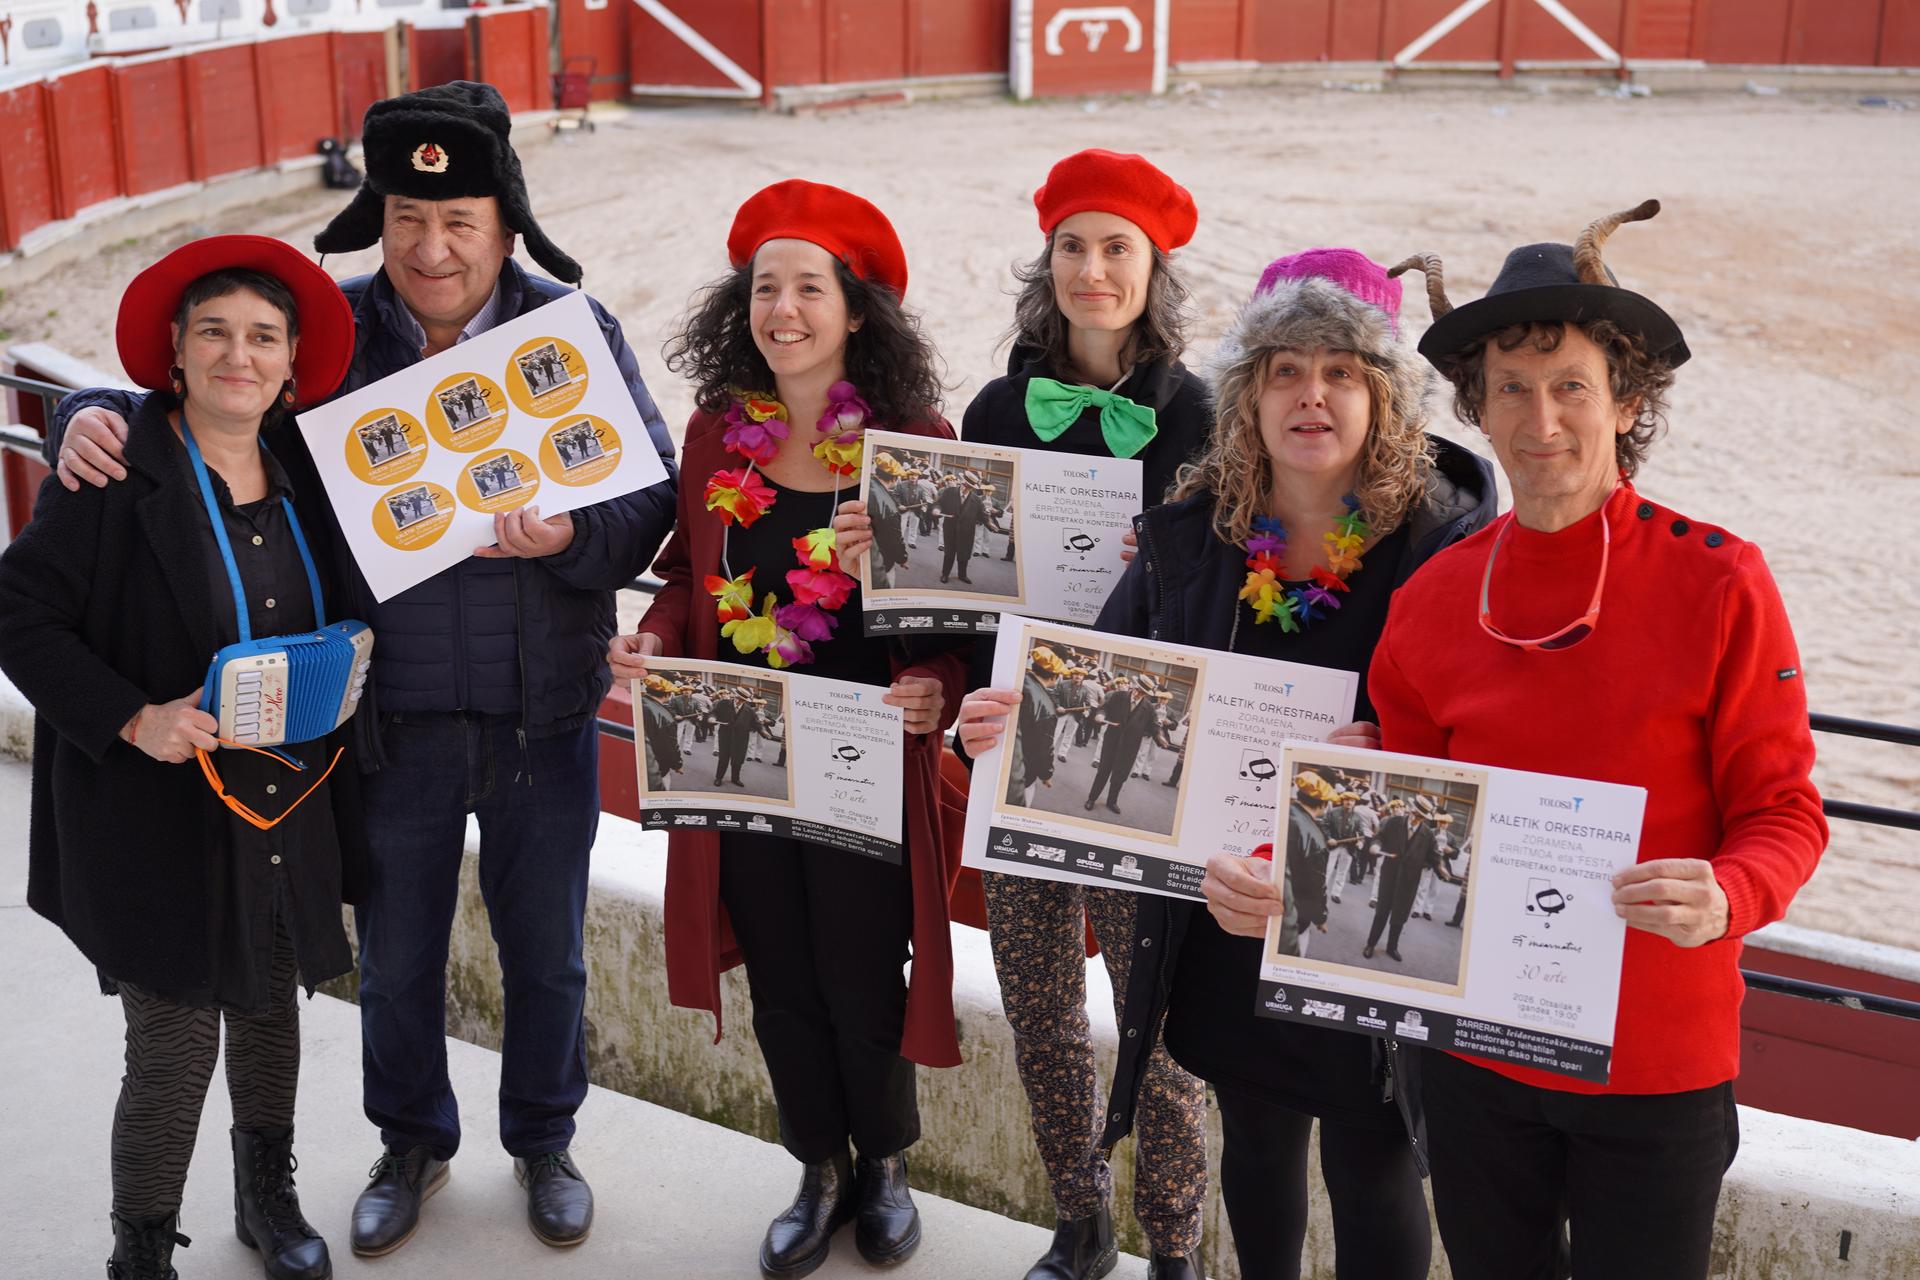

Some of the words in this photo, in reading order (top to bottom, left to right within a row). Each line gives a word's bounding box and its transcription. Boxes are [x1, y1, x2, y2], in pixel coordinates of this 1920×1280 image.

[1025, 482, 1067, 494] KALETIK
[1070, 487, 1138, 500] ORKESTRARA
[1036, 504, 1080, 515] ERRITMOA
[1099, 510, 1127, 519] FESTA
[1087, 519, 1132, 529] KONTZERTUA
[1064, 582, 1082, 593] 30
[795, 699, 833, 711] KALETIK
[837, 705, 899, 721] ORKESTRARA
[1208, 693, 1255, 709] KALETIK
[1259, 702, 1336, 725] ORKESTRARA
[1216, 718, 1266, 735] ERRITMOA
[1271, 730, 1285, 739] eta
[1238, 713, 1296, 730] ZORAMENA,
[866, 727, 890, 736] FESTA
[853, 734, 895, 746] KONTZERTUA
[830, 789, 847, 800] 30
[1227, 820, 1250, 833] 30
[1490, 813, 1540, 829] KALETIK
[1544, 821, 1632, 844] ORKESTRARA
[1499, 843, 1553, 860] ERRITMOA
[1557, 853, 1574, 863] eta
[1578, 855, 1614, 868] FESTA
[1168, 872, 1180, 880] eta
[1169, 863, 1208, 876] SARRERA
[1560, 867, 1613, 881] KONTZERTU
[1166, 879, 1201, 893] Sarrerare
[1516, 964, 1541, 980] 30
[1265, 1001, 1293, 1012] URMUGA
[1456, 1018, 1503, 1035] SARRERAK:
[1455, 1029, 1468, 1038] eta
[1470, 1031, 1516, 1048] Leidorreko
[1454, 1038, 1506, 1055] Sarrerarekin
[1508, 1050, 1530, 1061] disko
[1533, 1054, 1558, 1066] berria
[1560, 1060, 1582, 1071] opari
